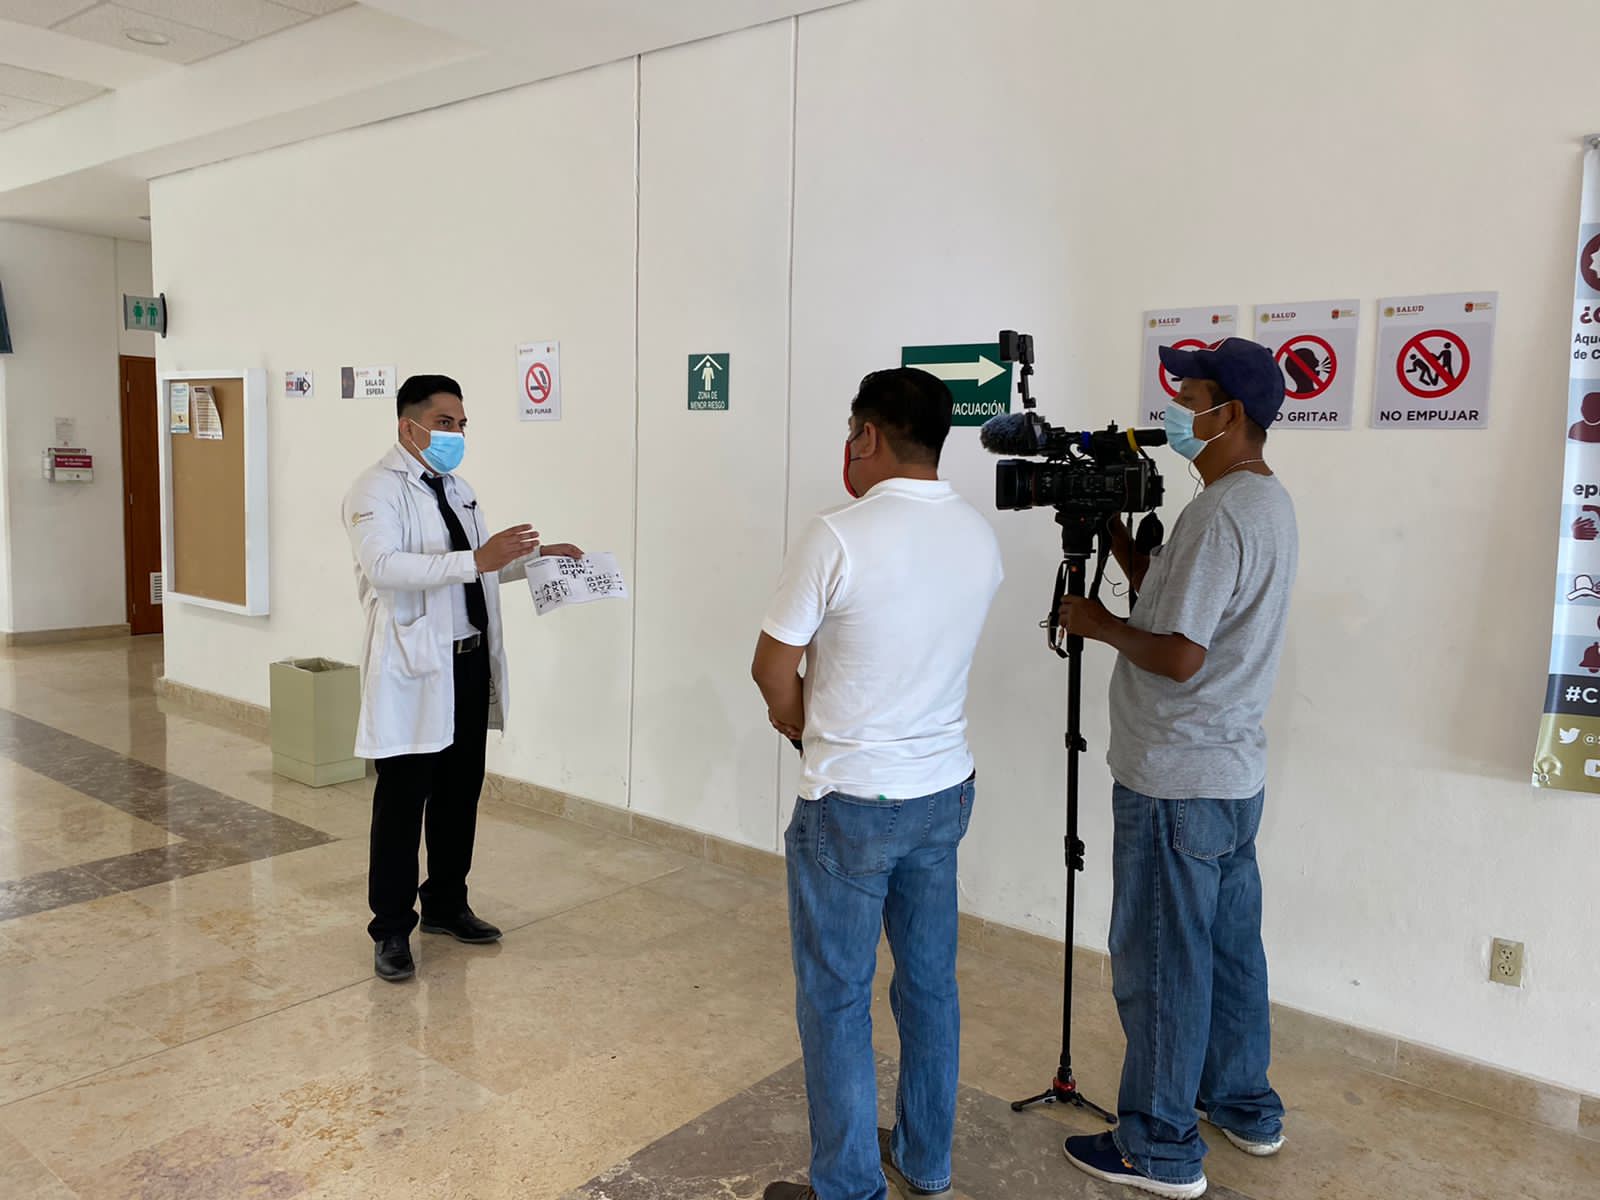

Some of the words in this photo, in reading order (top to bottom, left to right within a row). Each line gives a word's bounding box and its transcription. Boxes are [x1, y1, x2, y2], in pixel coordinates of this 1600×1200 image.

[1396, 305, 1424, 313] SALUD
[1575, 333, 1600, 346] Aqu
[1574, 350, 1587, 360] de
[1288, 411, 1338, 422] GRITAR
[1380, 410, 1402, 421] NO
[1407, 410, 1480, 421] EMPUJAR
[1573, 484, 1600, 499] ep
